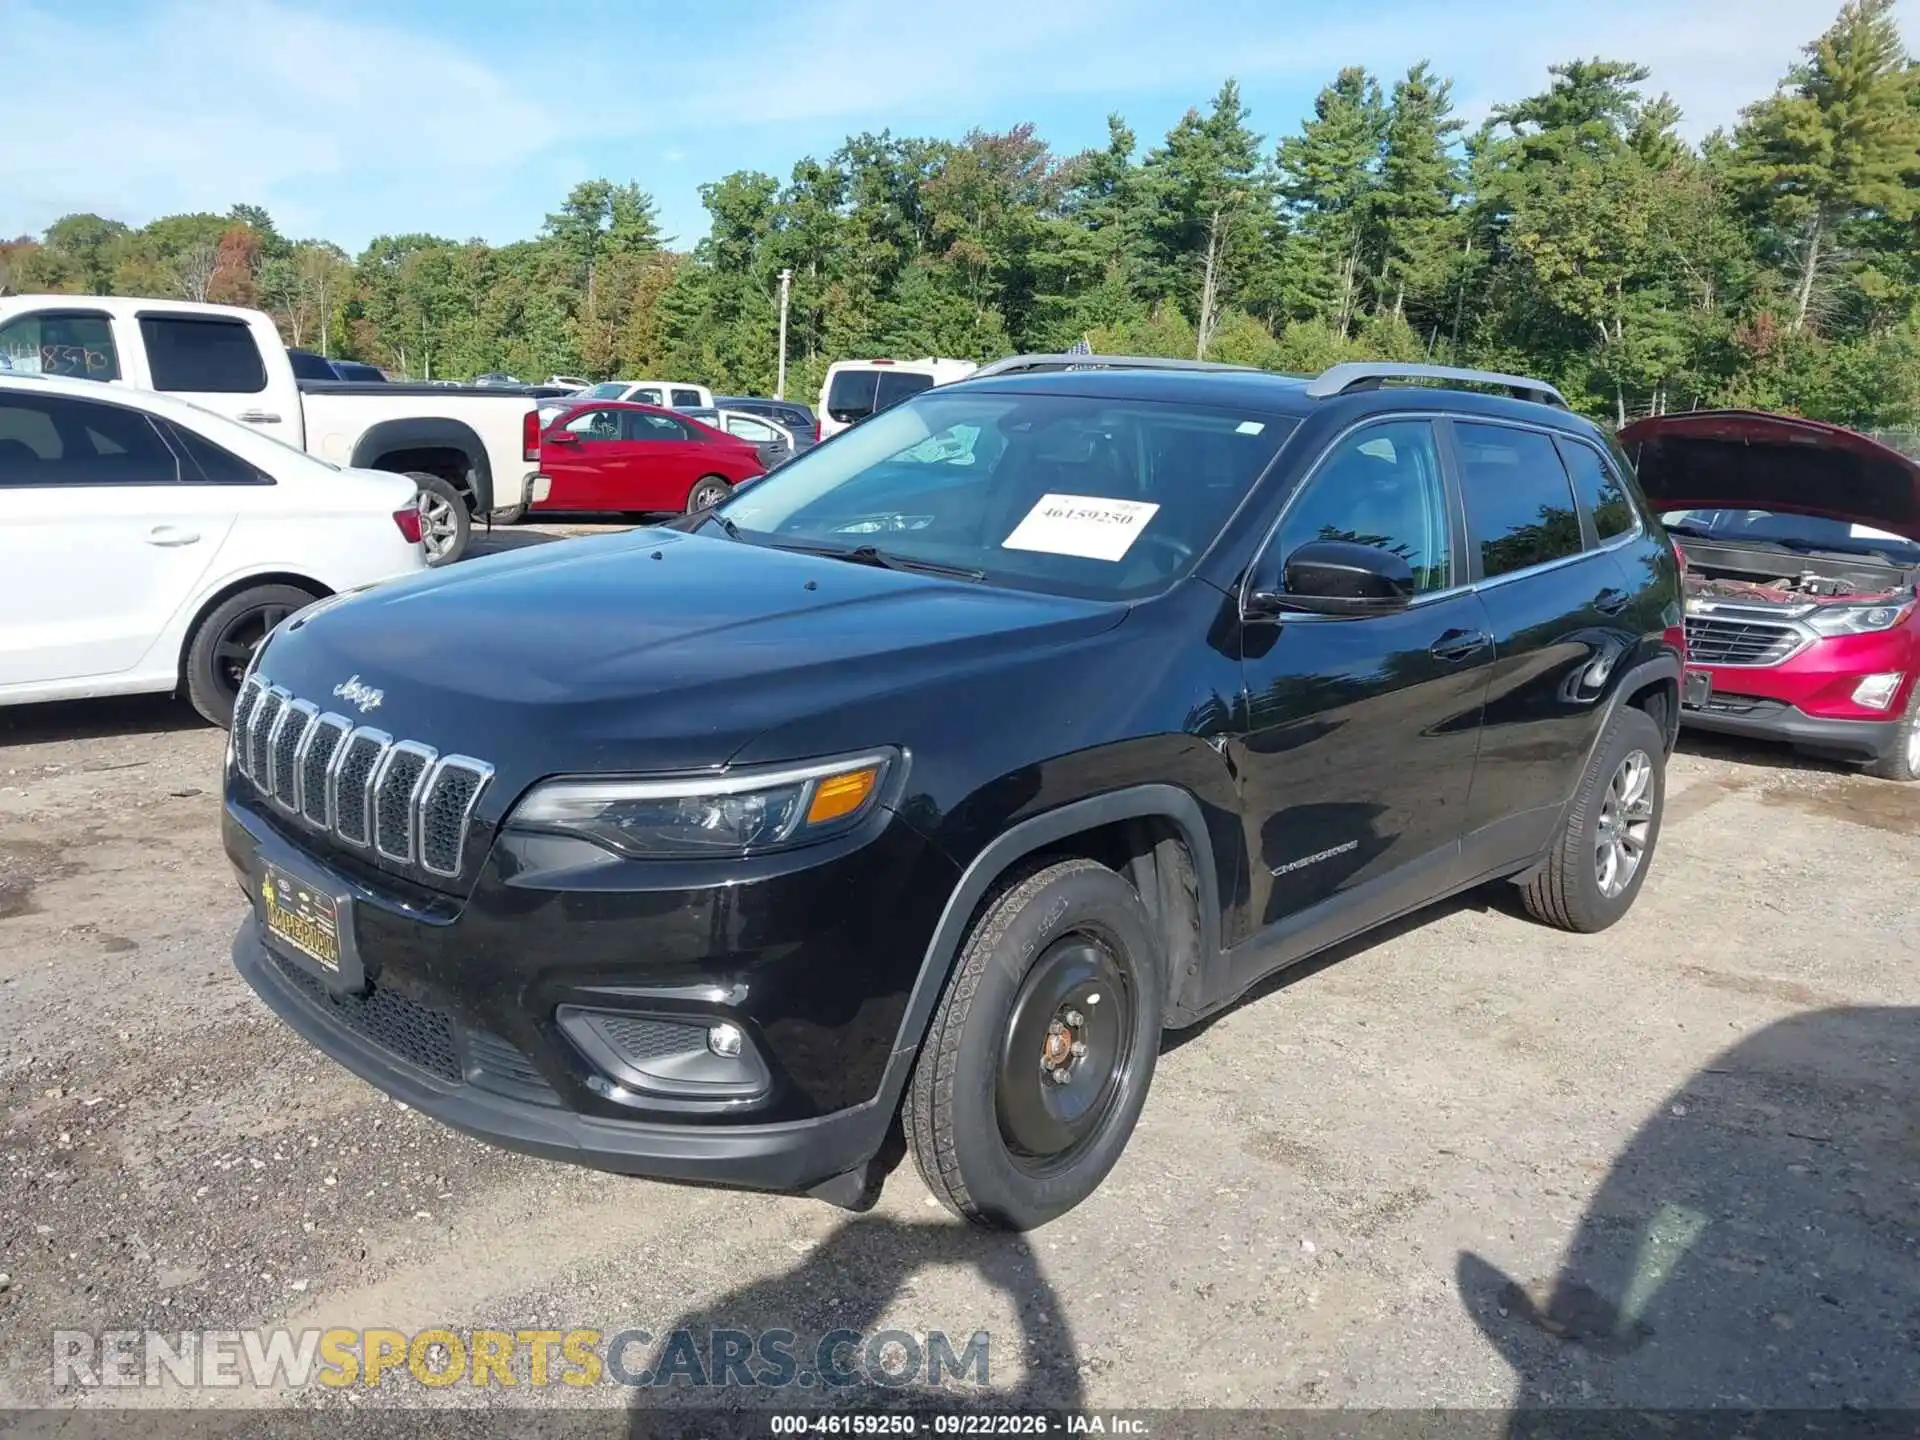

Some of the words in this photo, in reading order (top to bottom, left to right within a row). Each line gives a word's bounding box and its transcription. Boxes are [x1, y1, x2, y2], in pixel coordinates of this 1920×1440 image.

[1042, 507, 1134, 525] 46159250
[333, 675, 385, 713] Jeep
[1271, 840, 1359, 877] CHEROKEE
